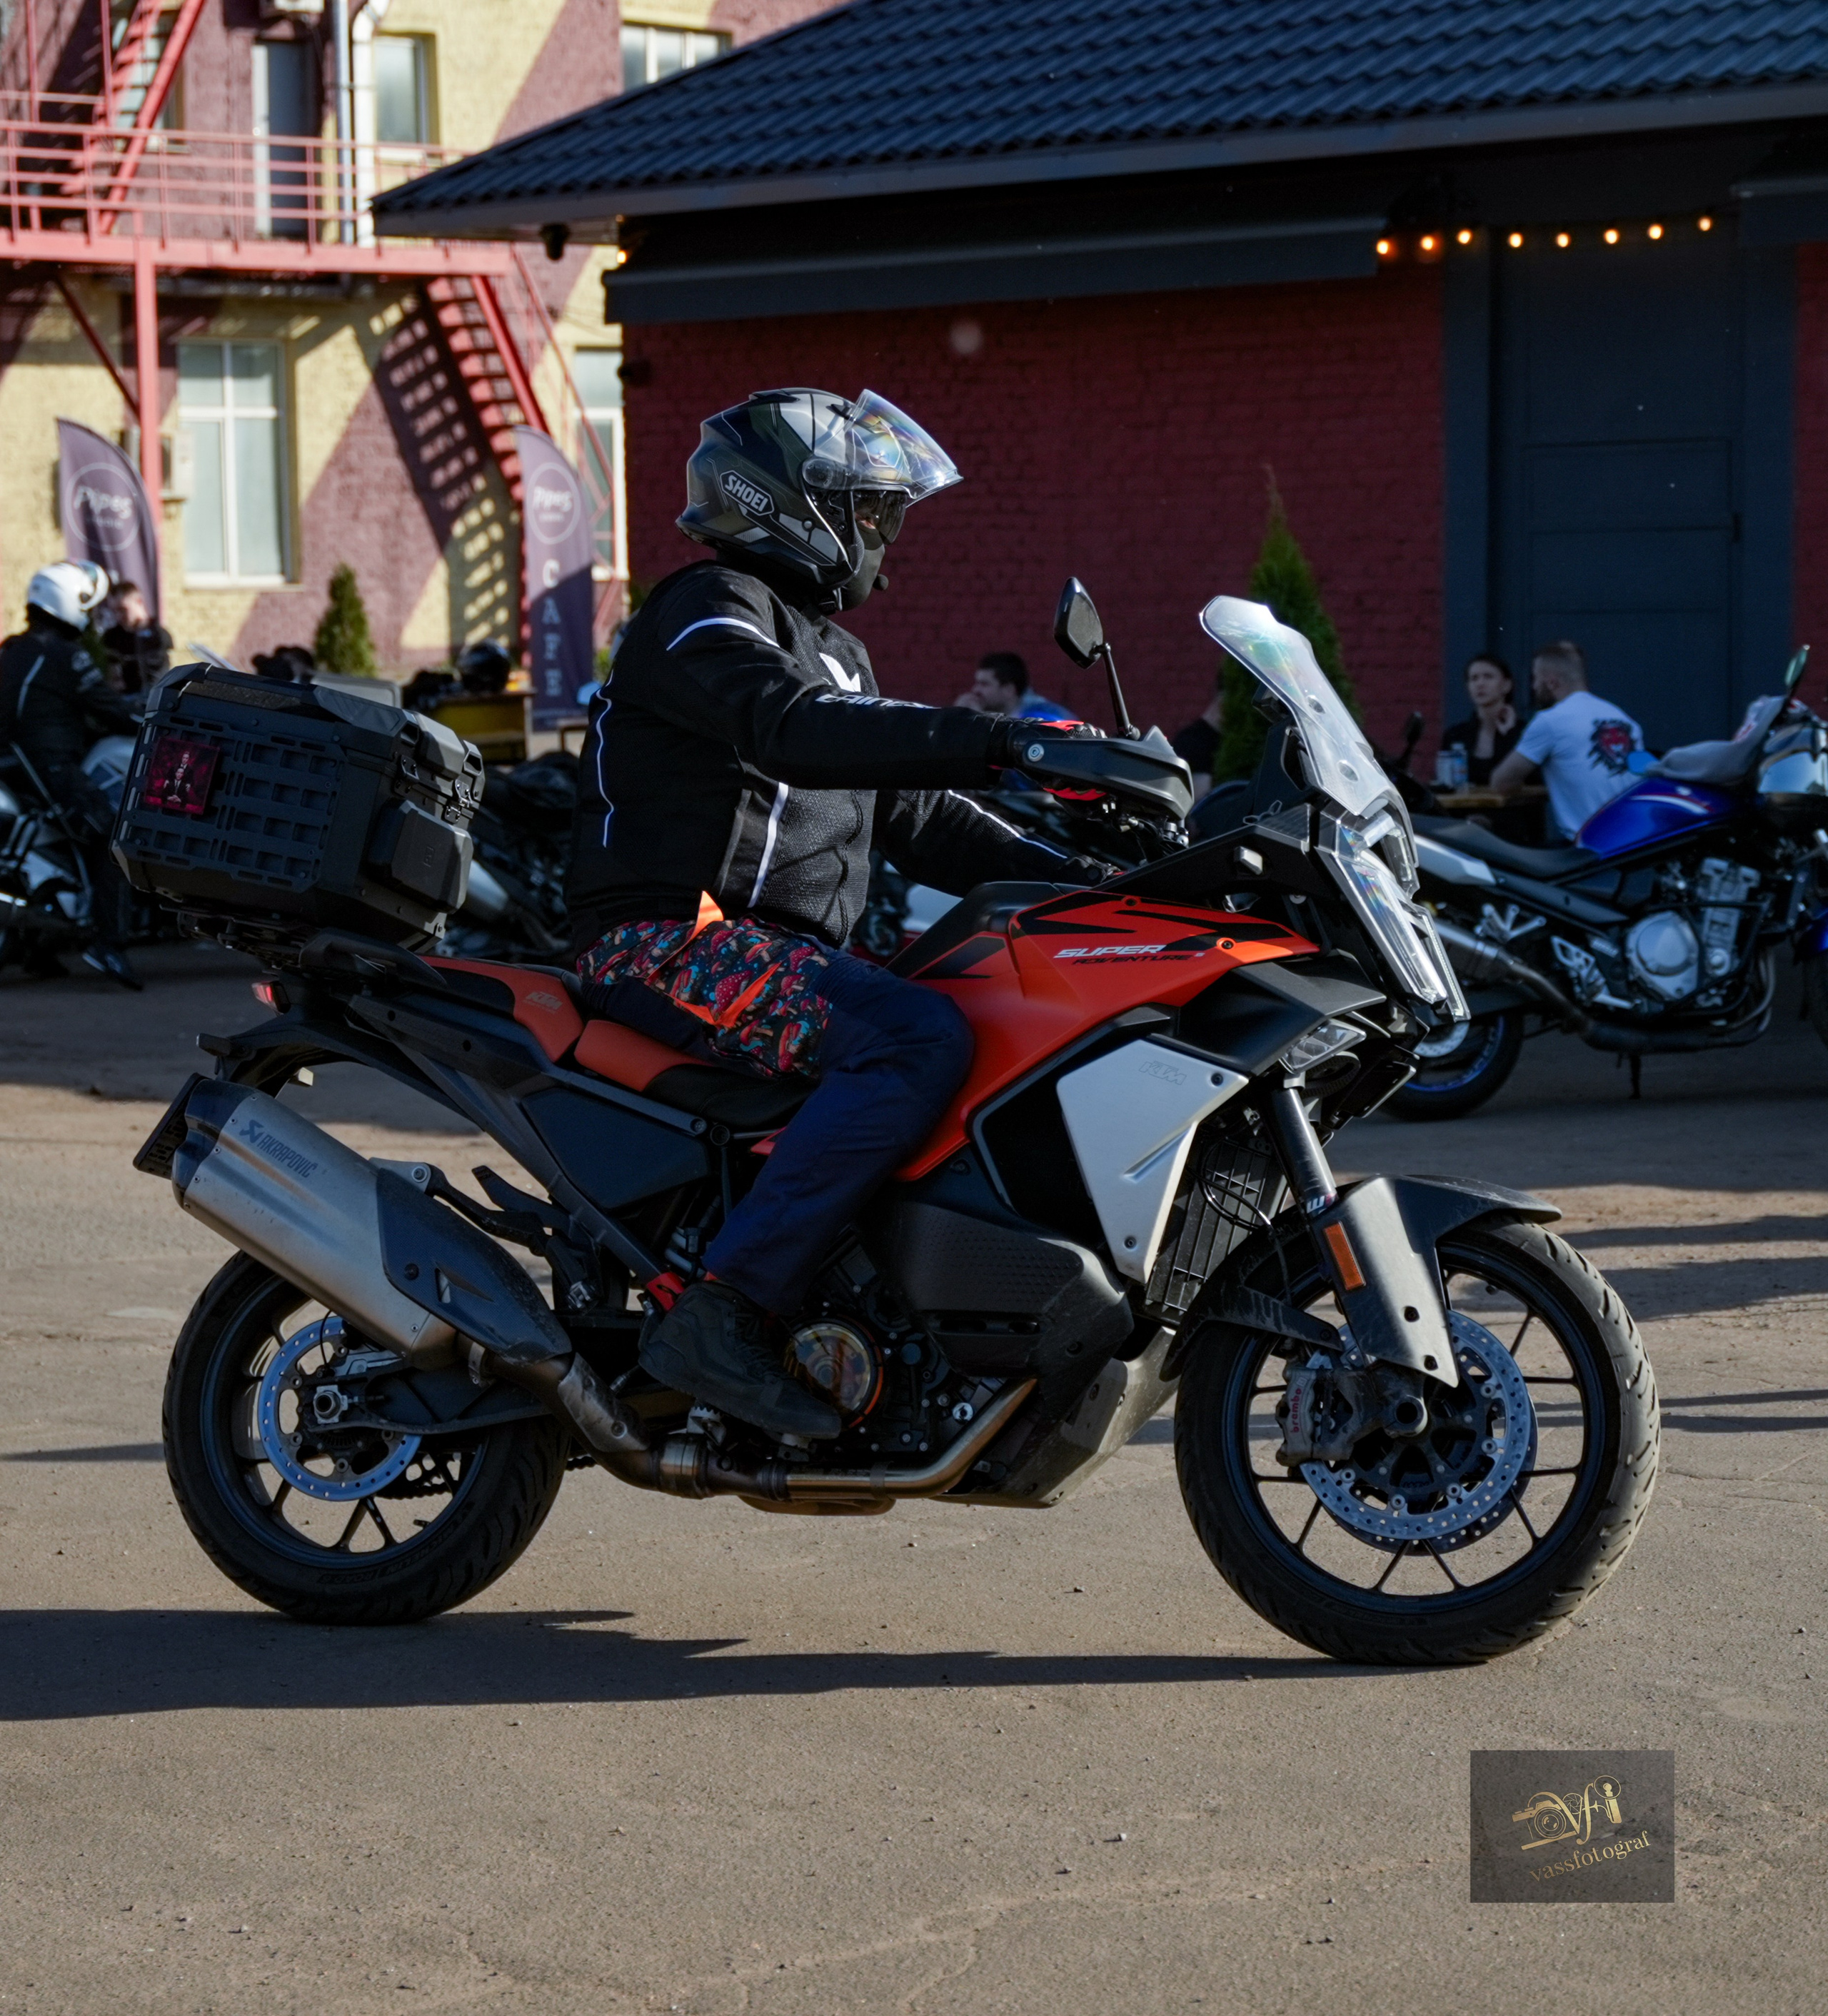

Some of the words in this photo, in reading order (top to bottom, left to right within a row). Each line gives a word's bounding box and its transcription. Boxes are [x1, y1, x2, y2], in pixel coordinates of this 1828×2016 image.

[724, 474, 768, 512] SHOEI
[1053, 944, 1167, 959] SUPER
[1071, 954, 1192, 965] ADVENTURE
[526, 991, 563, 1011] KTM
[1138, 1060, 1187, 1086] KTM
[1290, 1385, 1304, 1434] brembo
